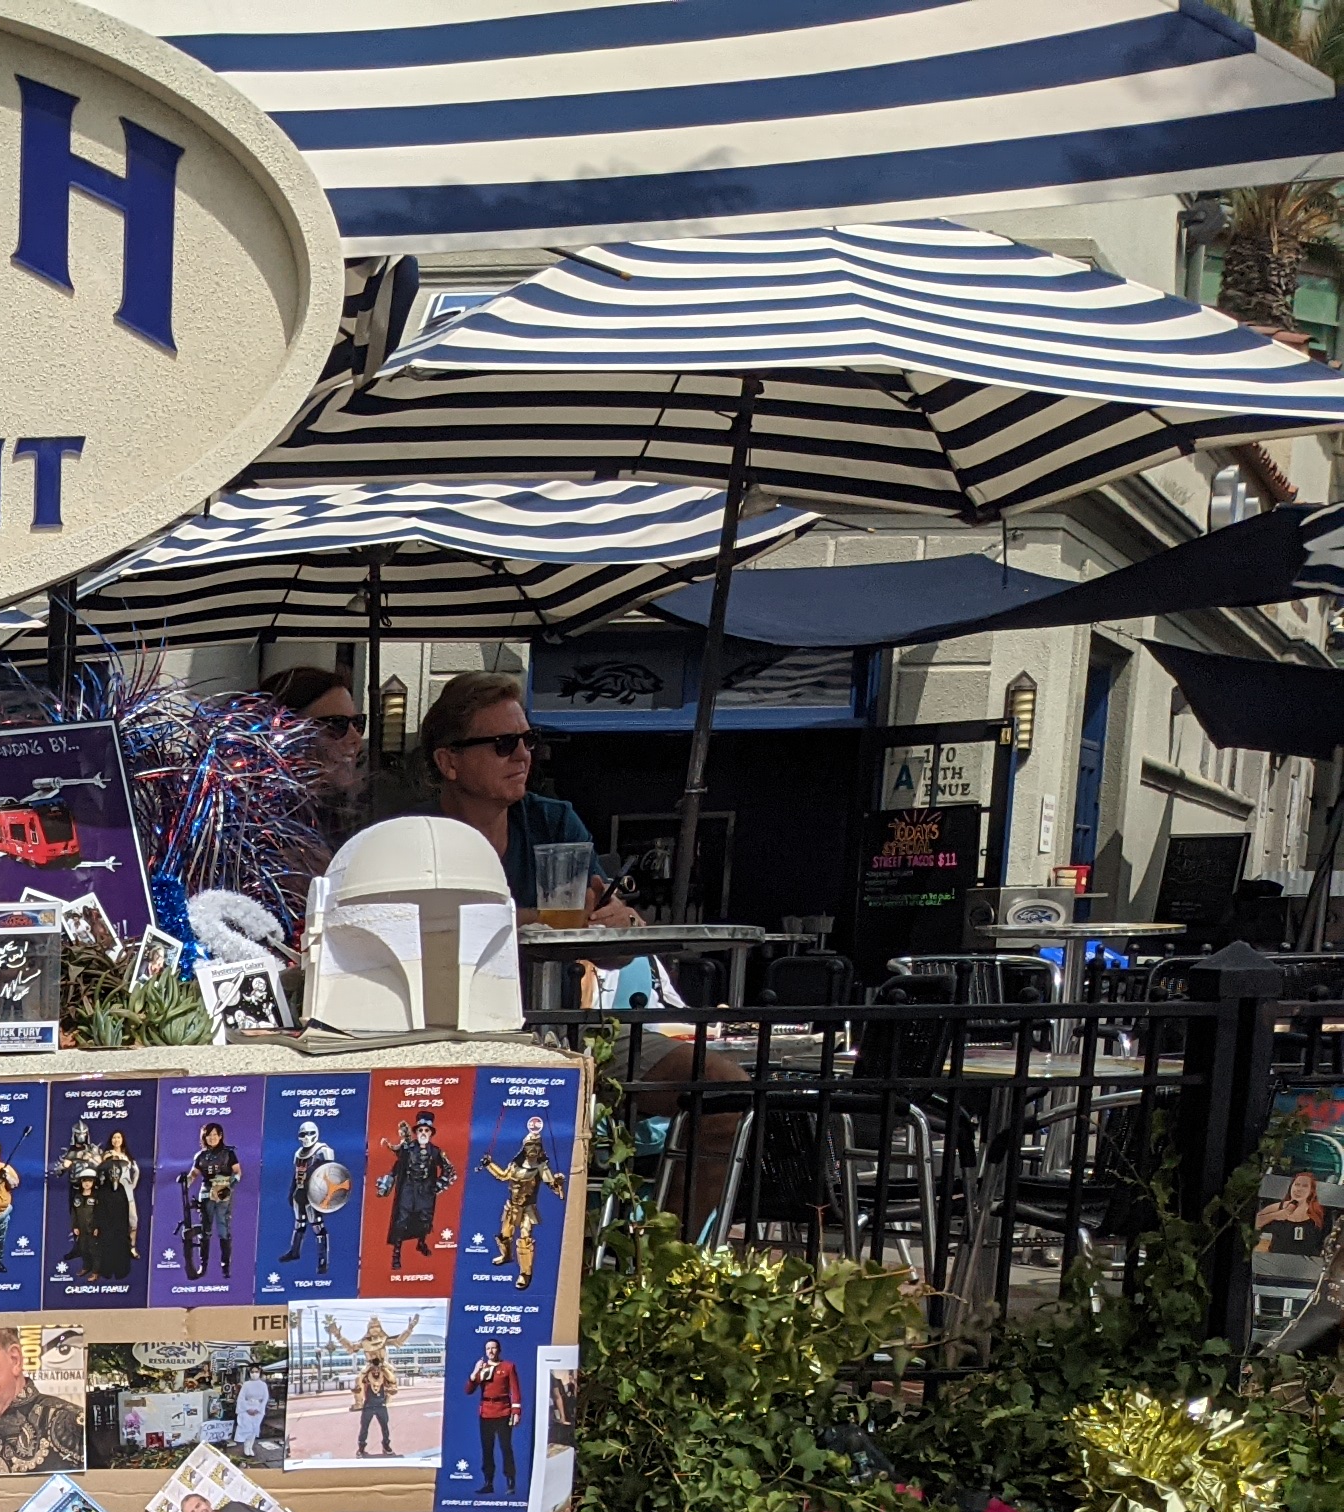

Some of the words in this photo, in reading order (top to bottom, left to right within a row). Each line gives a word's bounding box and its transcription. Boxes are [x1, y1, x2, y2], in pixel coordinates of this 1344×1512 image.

[893, 764, 914, 790] A
[906, 855, 935, 867] TACOS
[937, 852, 958, 866] $11
[21, 1027, 41, 1037] FURY
[64, 1090, 80, 1098] SAN
[80, 1090, 103, 1098] DIEGO
[126, 1089, 142, 1097] CON
[86, 1098, 125, 1109] SHRINE
[80, 1110, 101, 1120] JULY
[65, 1285, 100, 1294] CHURCH
[101, 1284, 130, 1294] FAMILY
